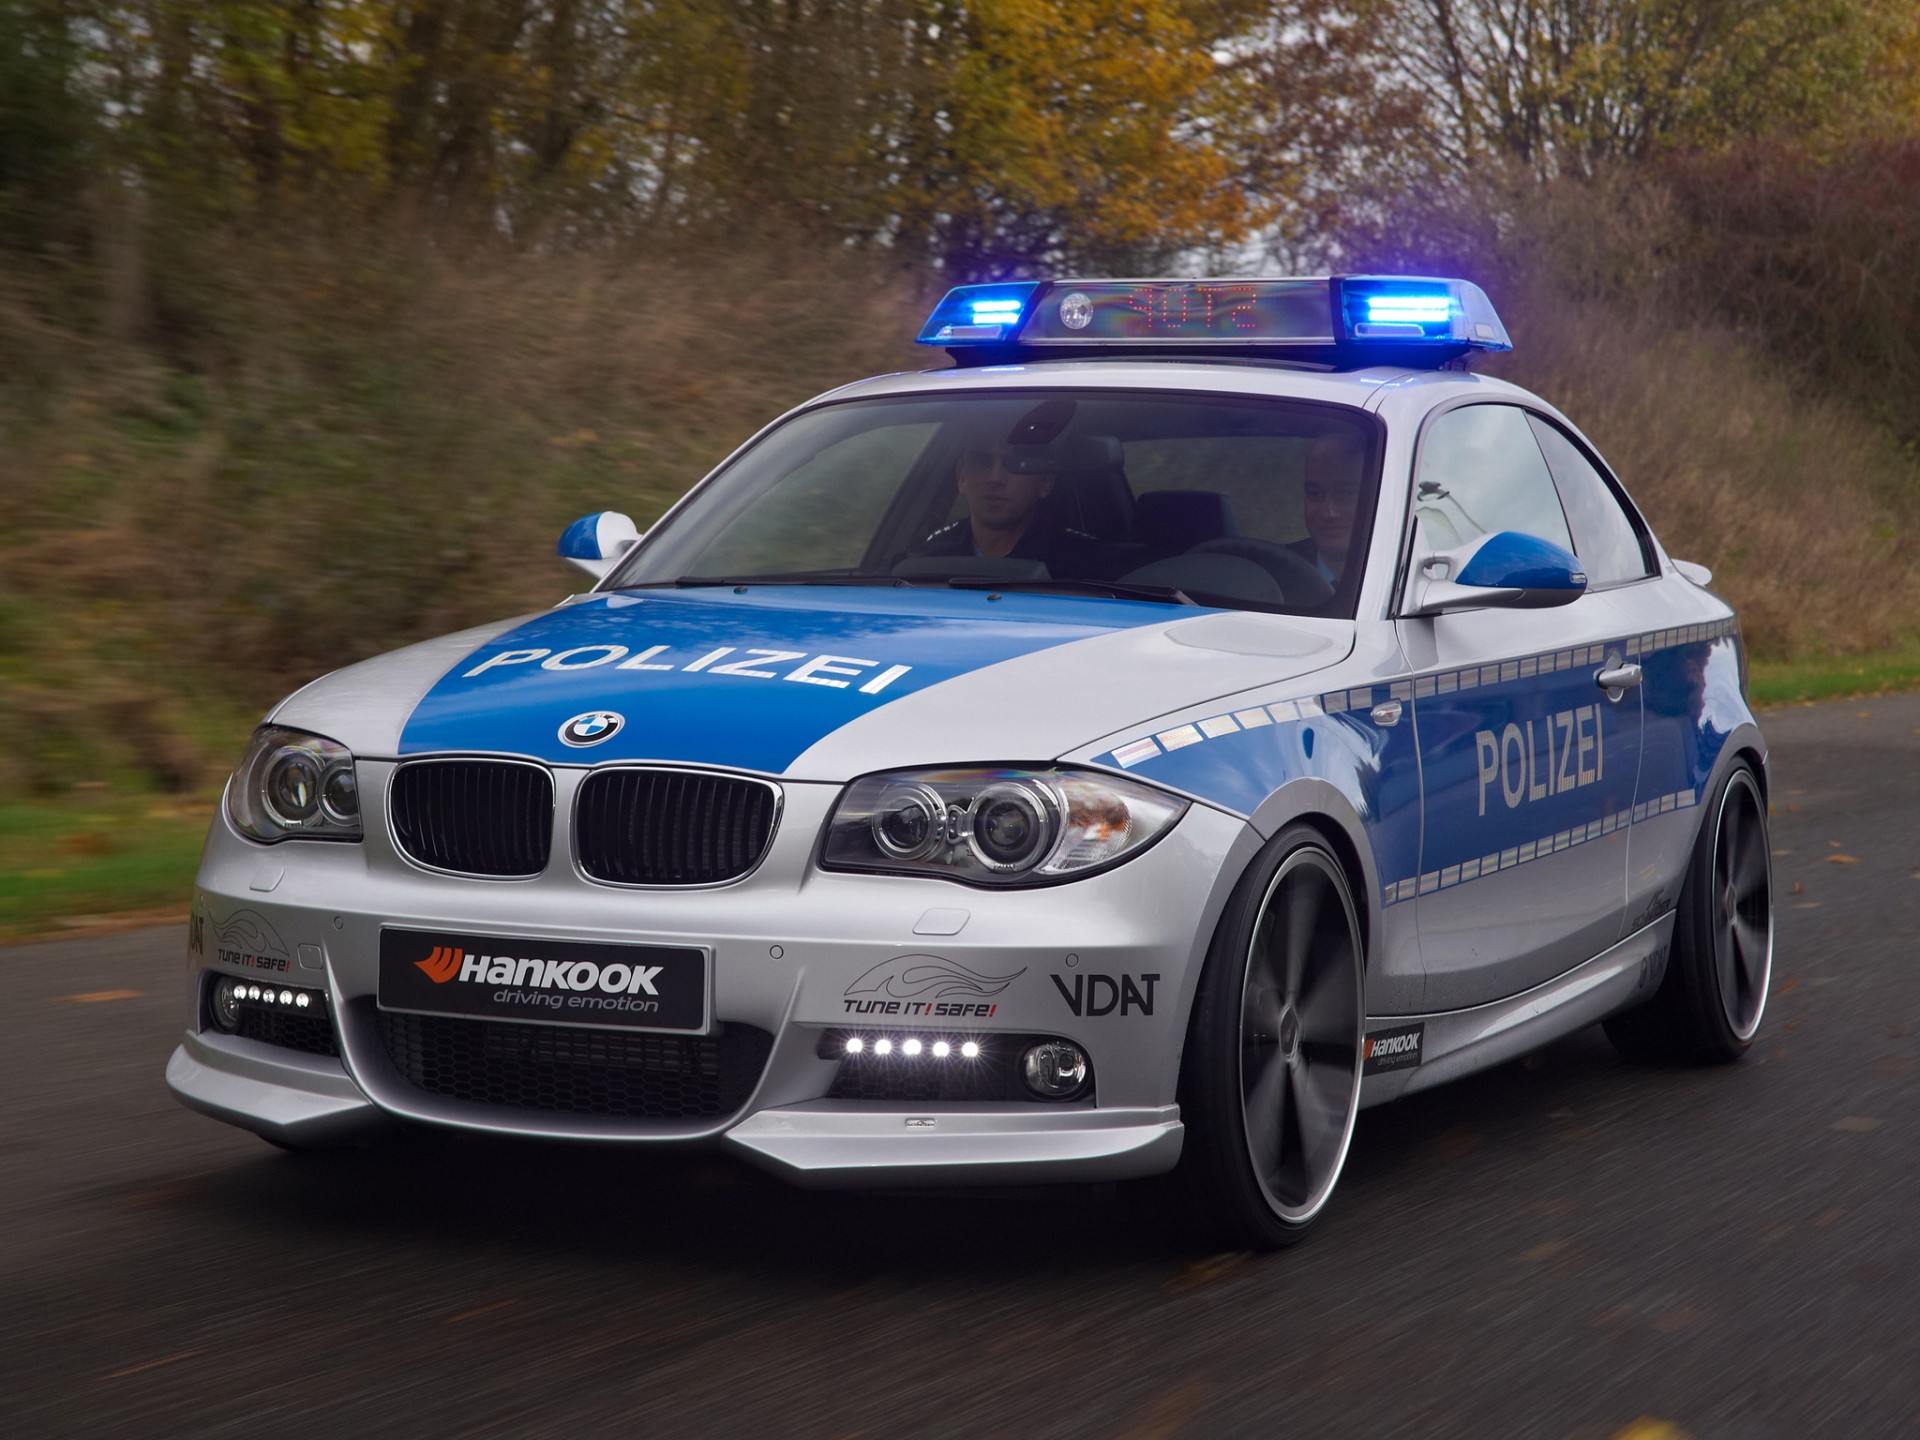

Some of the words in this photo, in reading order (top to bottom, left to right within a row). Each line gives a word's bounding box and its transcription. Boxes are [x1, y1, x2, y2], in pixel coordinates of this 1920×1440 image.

[462, 645, 912, 694] POLIZEI
[1475, 703, 1603, 817] POLIZEI
[493, 989, 563, 1009] driving
[568, 994, 659, 1013] emotion
[903, 1002, 933, 1016] IT!
